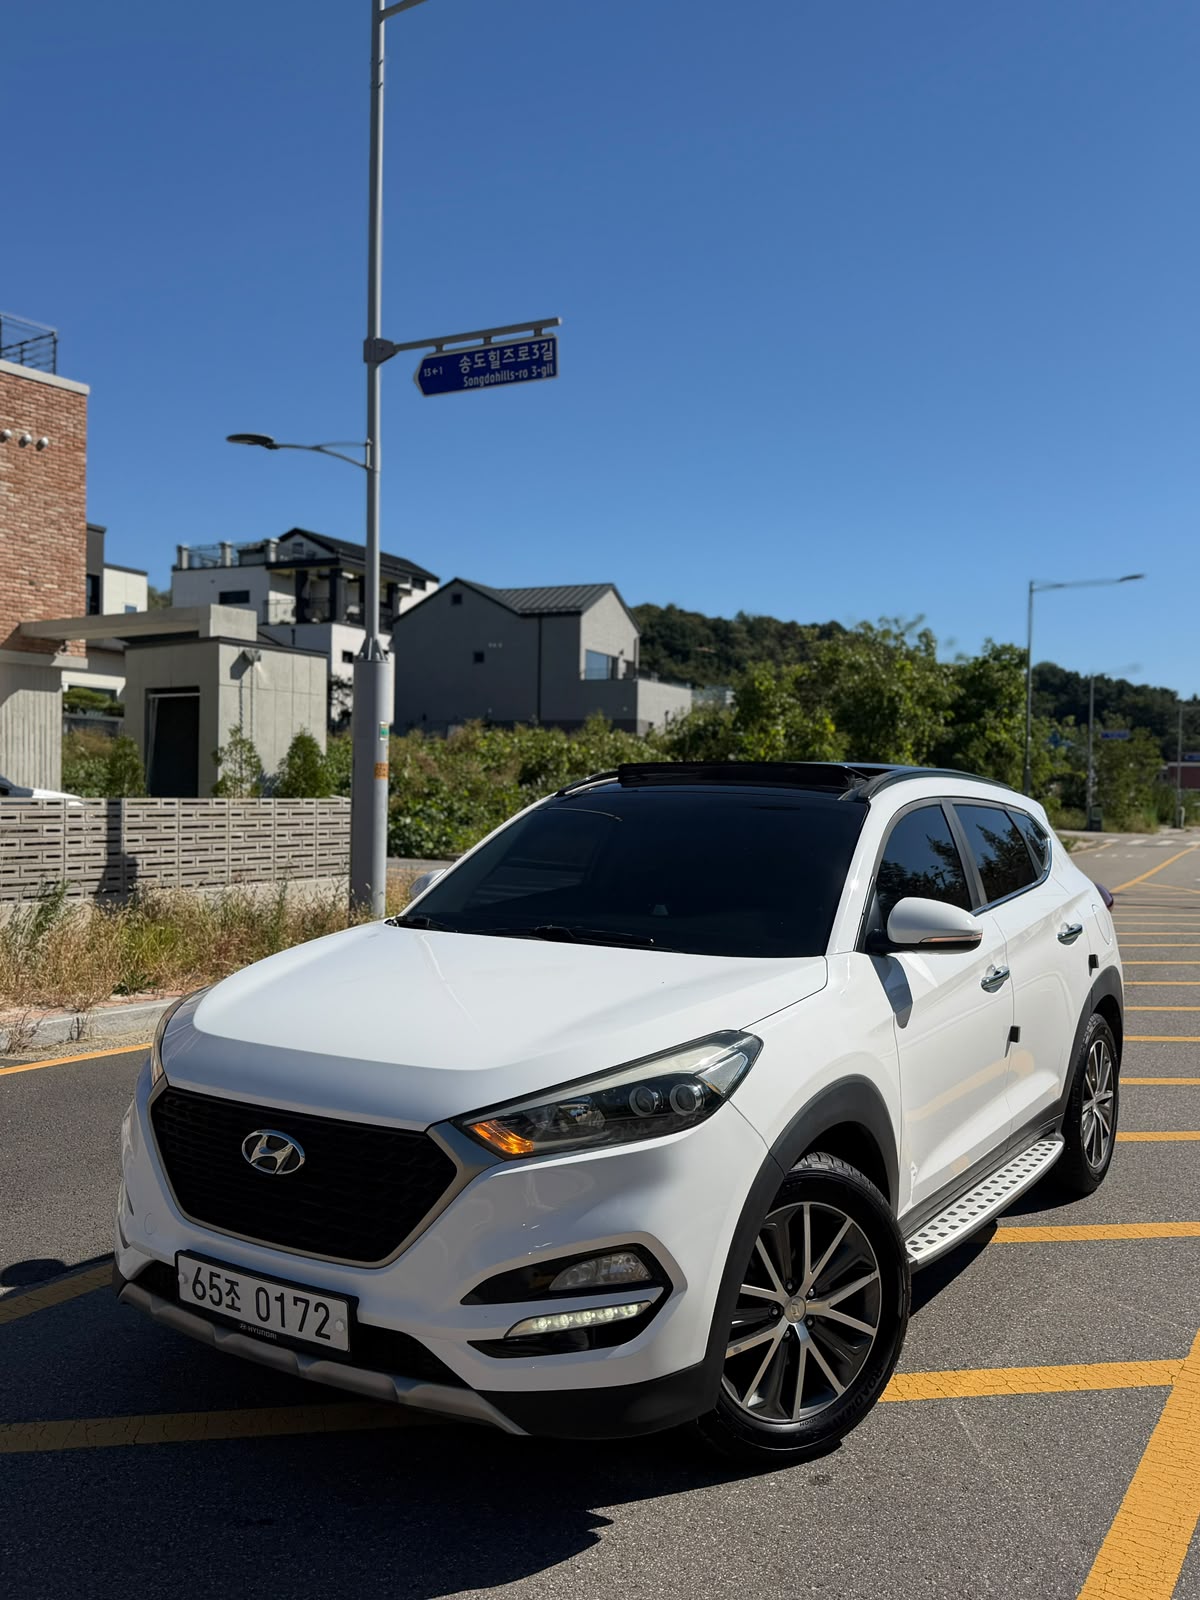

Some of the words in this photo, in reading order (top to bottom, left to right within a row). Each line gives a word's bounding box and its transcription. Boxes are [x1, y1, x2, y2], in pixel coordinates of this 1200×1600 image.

[459, 341, 553, 374] 송도힐즈로3길
[463, 368, 528, 387] Songdohills-ro
[531, 364, 553, 378] 3-gil
[192, 1266, 241, 1313] 65조
[255, 1286, 331, 1341] 0172
[247, 1325, 278, 1341] HYUNDAI
